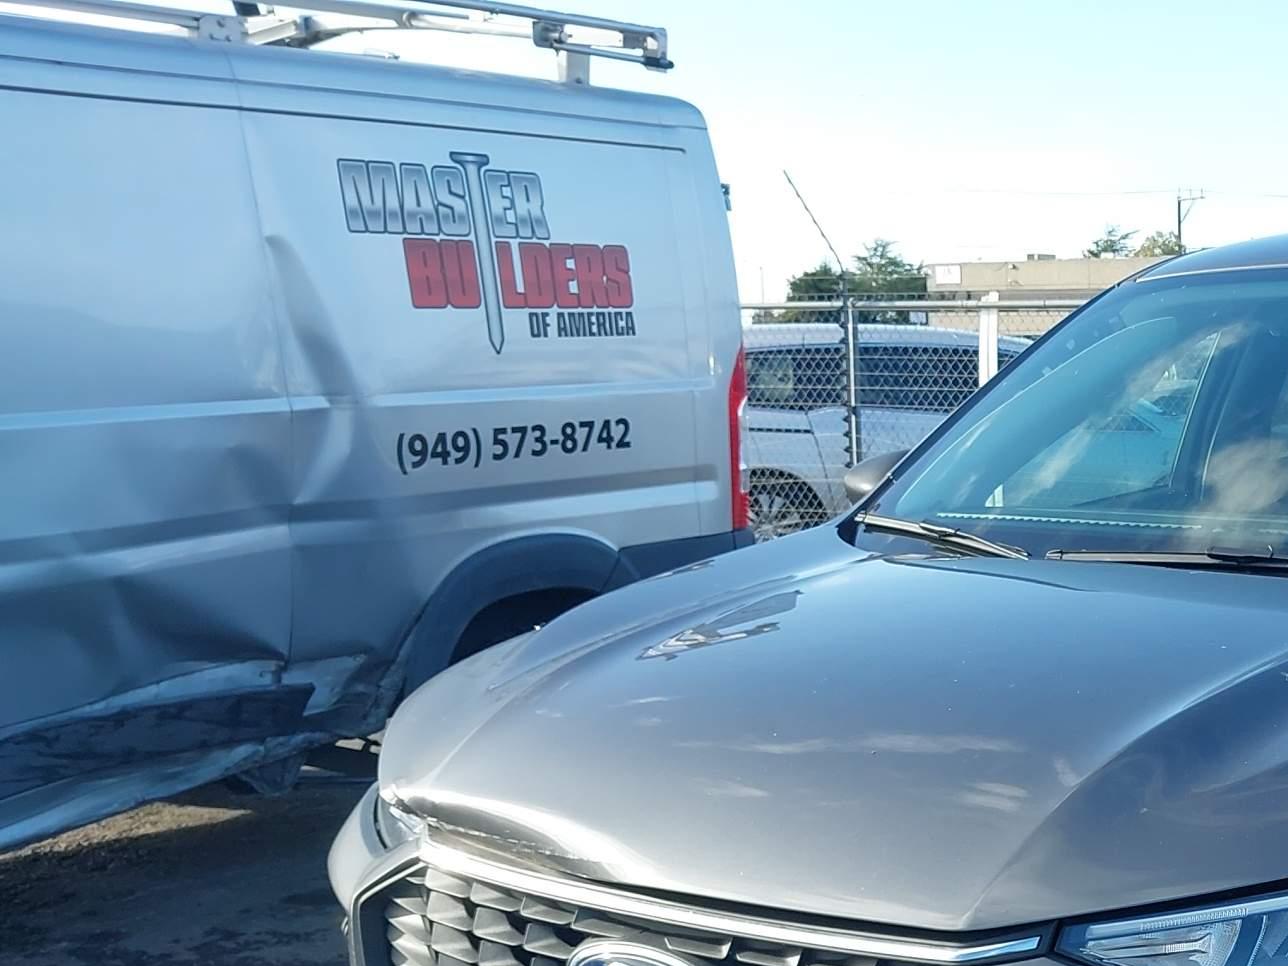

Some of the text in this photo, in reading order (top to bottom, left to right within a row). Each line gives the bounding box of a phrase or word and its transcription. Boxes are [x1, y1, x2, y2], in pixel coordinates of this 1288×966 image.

[337, 151, 550, 240] MASTER
[528, 311, 636, 338] OF AMERICA
[396, 418, 632, 476] (949) 573-8742
